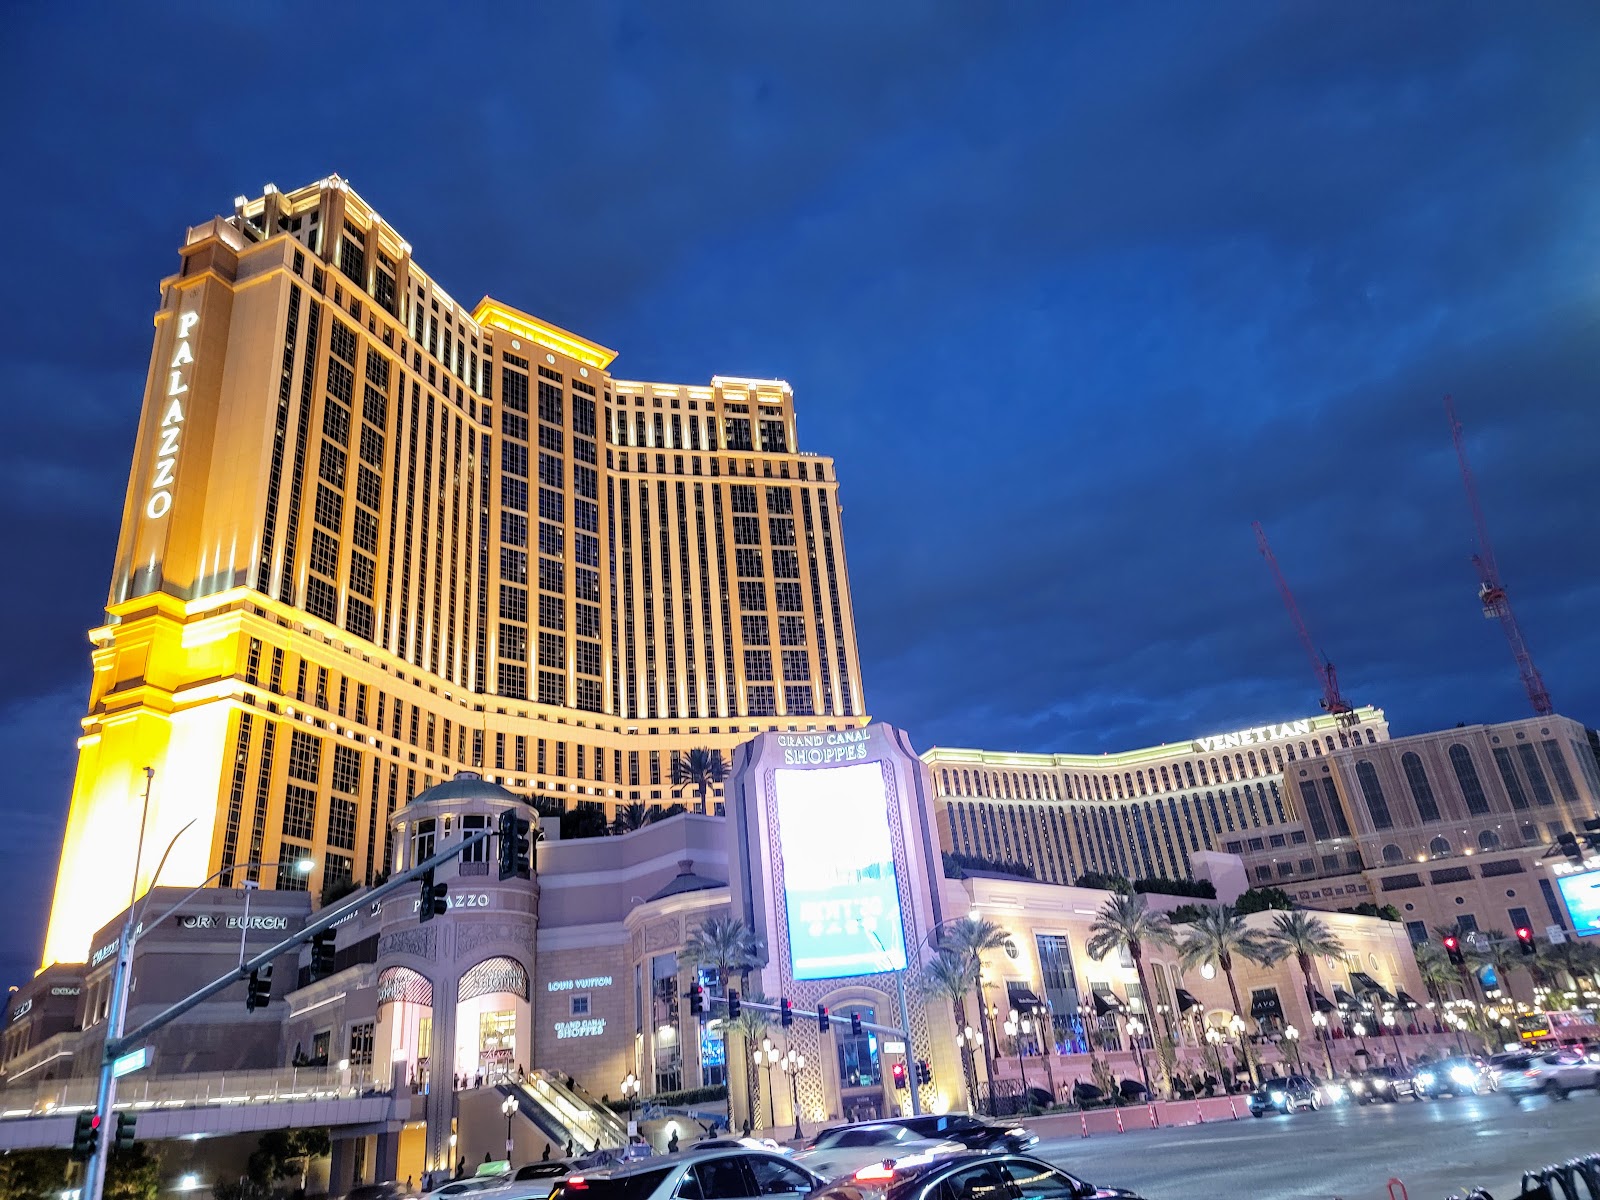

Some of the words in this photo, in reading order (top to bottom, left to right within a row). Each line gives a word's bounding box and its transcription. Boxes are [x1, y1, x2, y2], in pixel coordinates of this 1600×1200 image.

[146, 312, 199, 519] PALAZZO
[777, 734, 824, 747] GRAND
[826, 729, 871, 745] CANAL
[1195, 719, 1311, 752] VENETIAN
[784, 743, 867, 765] SHOPPES
[174, 915, 222, 928] TORY
[226, 915, 288, 930] BURCH
[548, 981, 573, 992] LOUIS
[575, 976, 612, 989] VUITTON
[554, 1020, 581, 1031] GRAND
[582, 1018, 606, 1029] CANAL
[557, 1026, 604, 1039] SHOPPES
